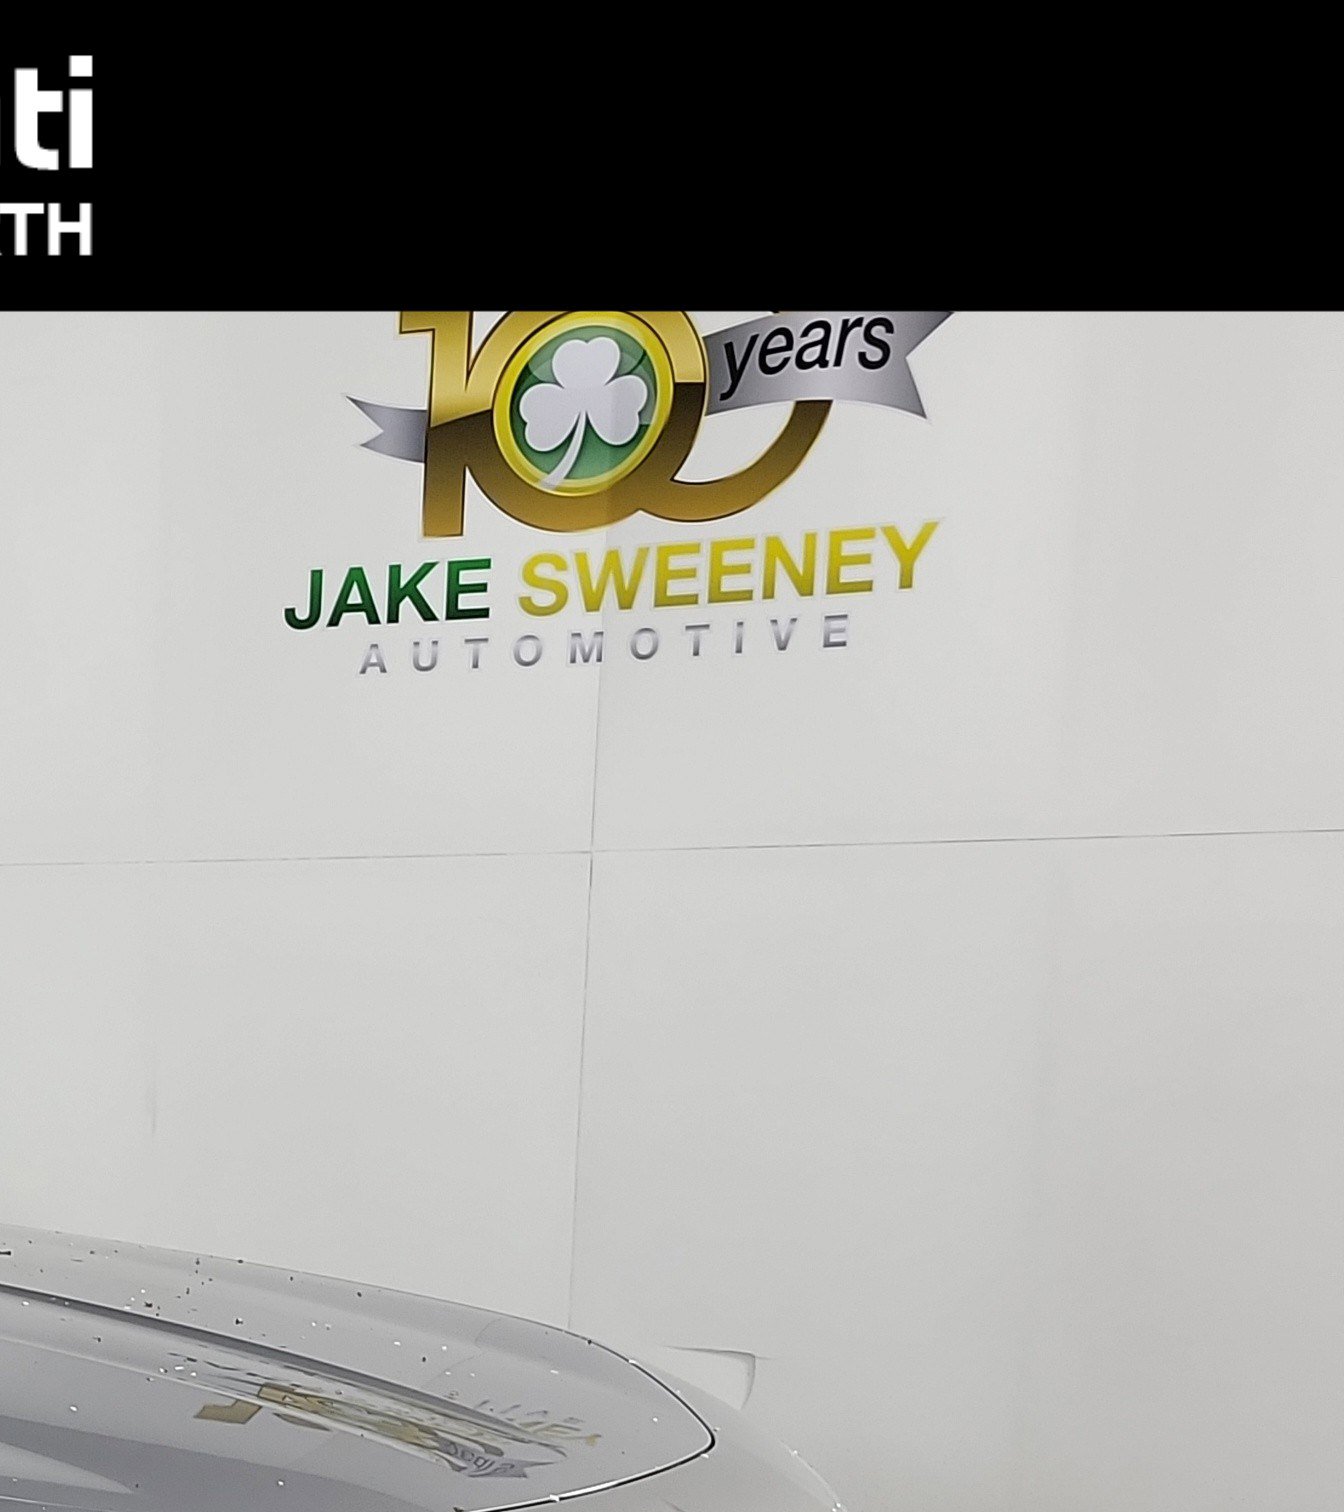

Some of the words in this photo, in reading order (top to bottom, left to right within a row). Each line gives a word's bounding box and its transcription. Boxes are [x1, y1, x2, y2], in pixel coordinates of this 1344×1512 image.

[719, 311, 895, 400] years
[283, 557, 493, 631] JAKE
[516, 520, 940, 617] SWEENEY
[358, 613, 849, 675] AUTOMOTIVE
